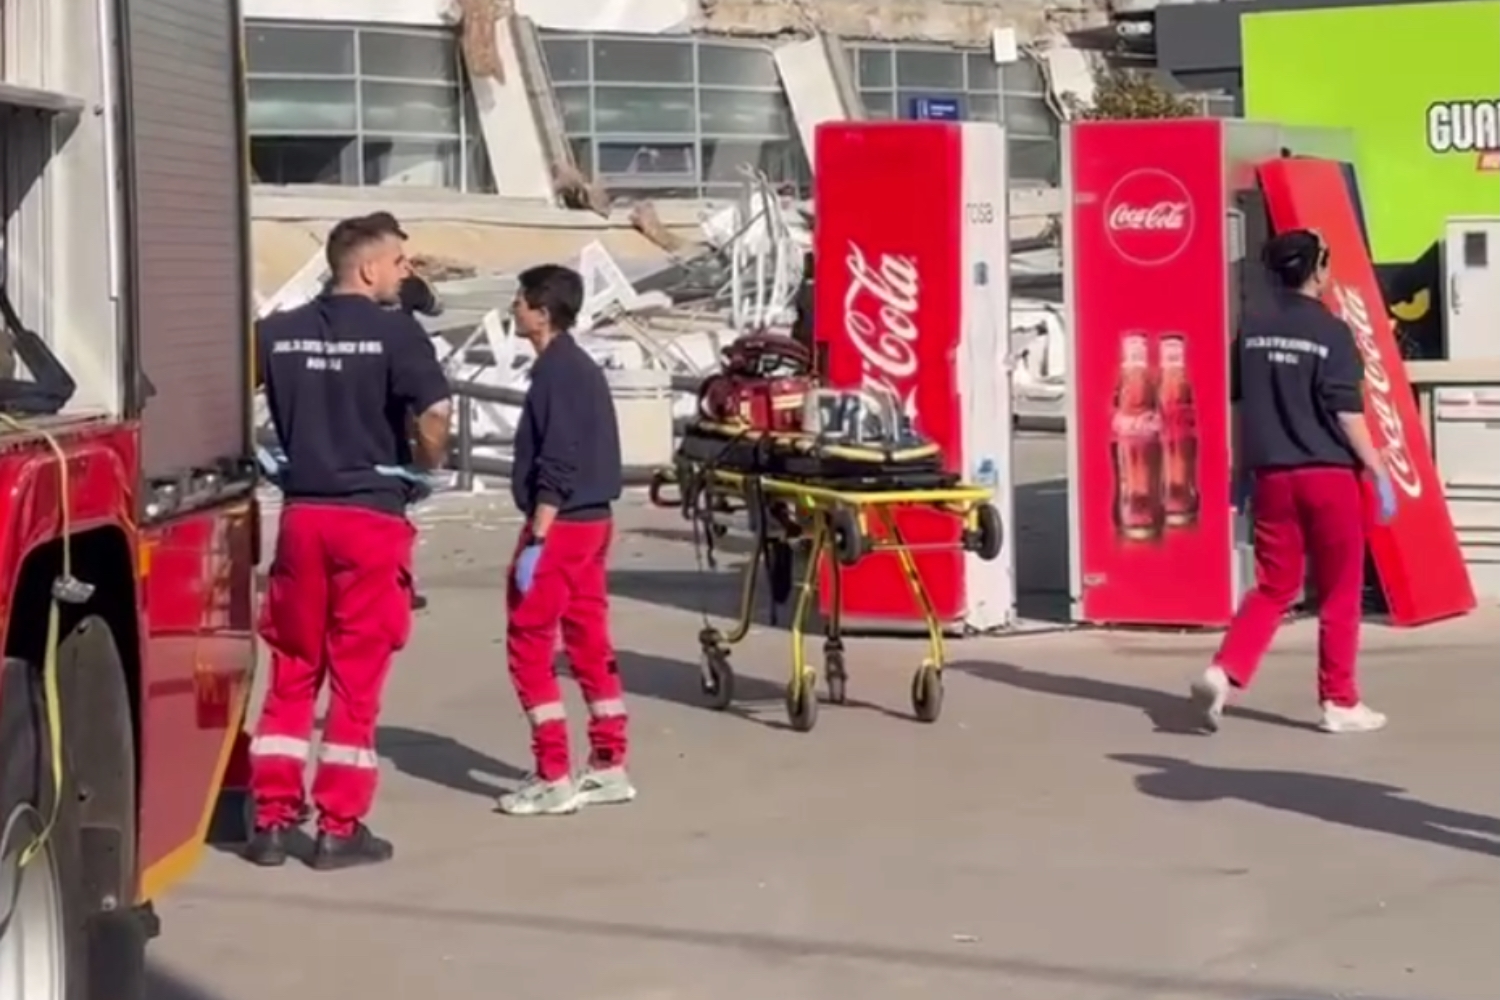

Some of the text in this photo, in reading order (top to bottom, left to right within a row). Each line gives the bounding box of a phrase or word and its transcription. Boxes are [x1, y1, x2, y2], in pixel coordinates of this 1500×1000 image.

[1428, 101, 1500, 151] GUA
[1109, 200, 1188, 230] Coca-Cola
[844, 239, 919, 417] -Cola
